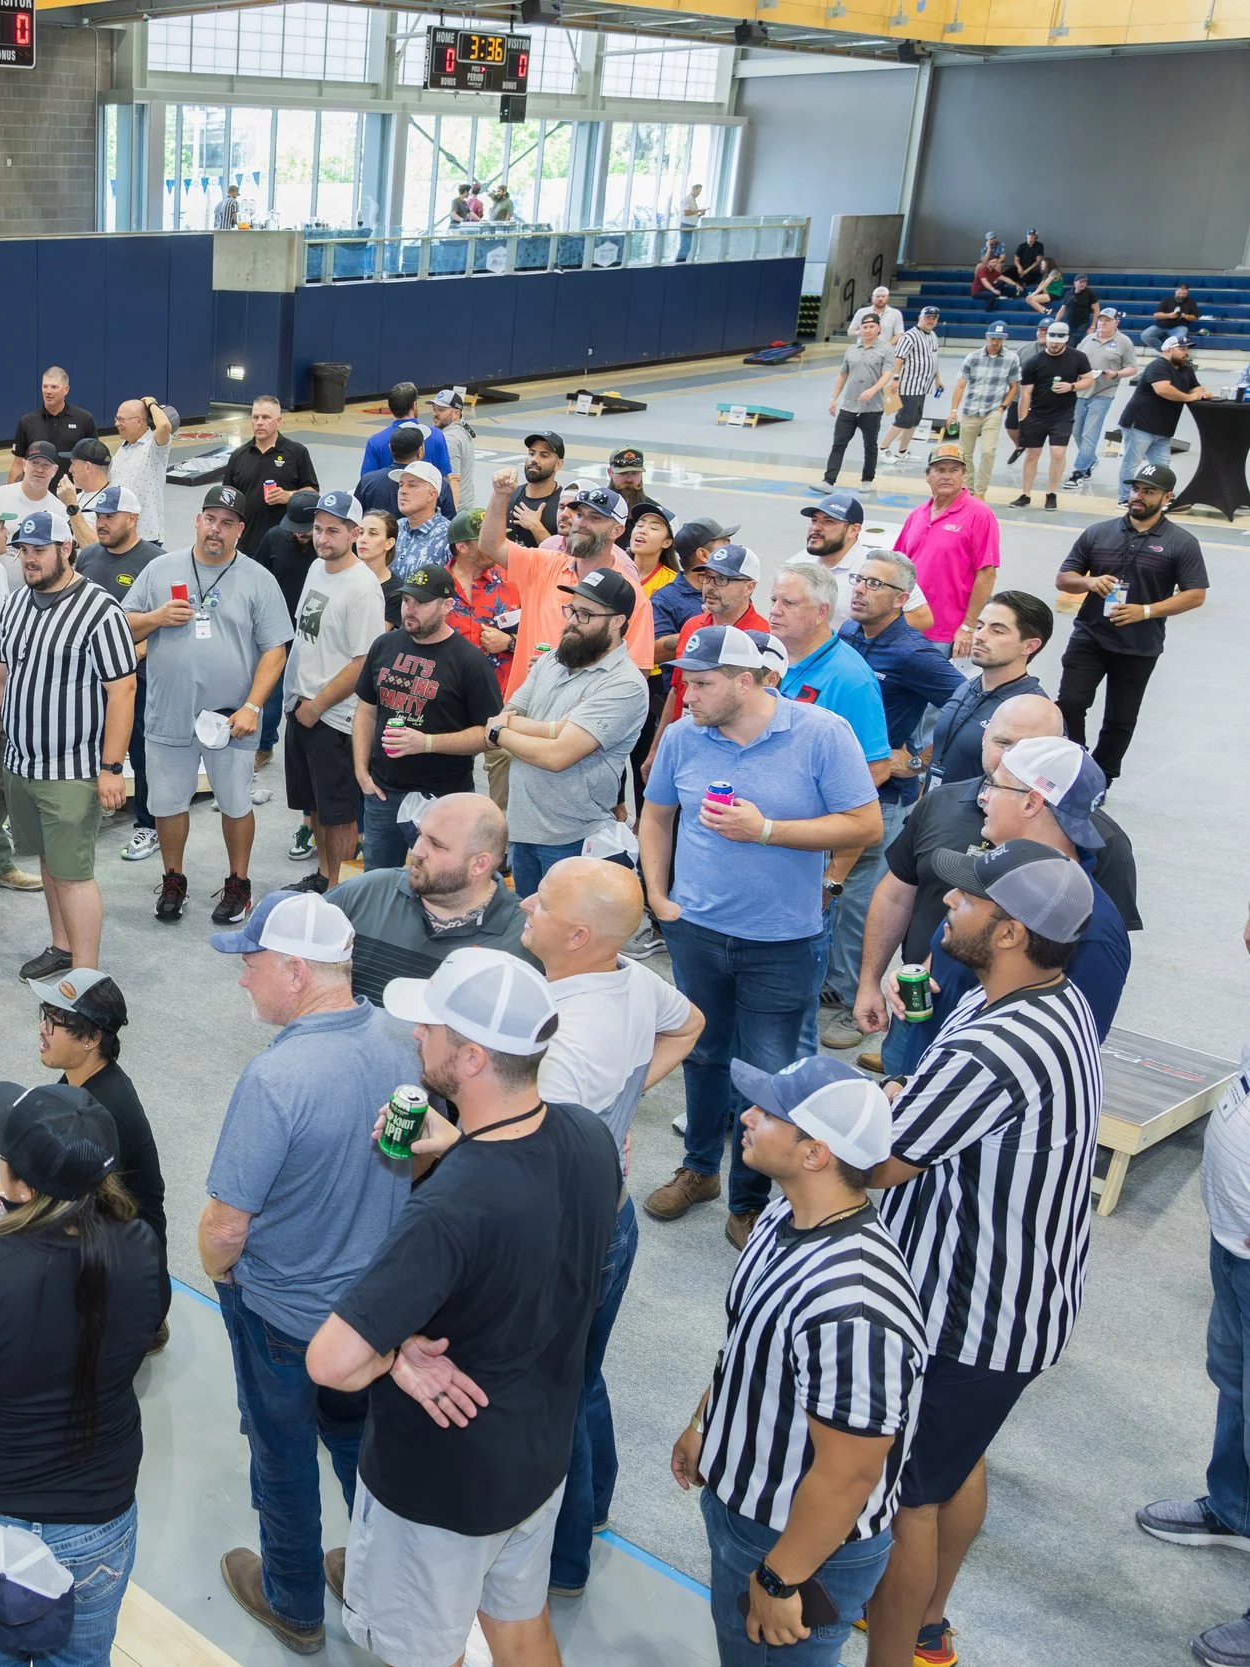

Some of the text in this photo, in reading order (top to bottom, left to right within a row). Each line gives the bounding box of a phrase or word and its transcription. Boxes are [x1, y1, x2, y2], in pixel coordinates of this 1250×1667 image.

[16, 13, 30, 45] 0
[435, 31, 455, 44] HOME
[470, 35, 503, 62] 3:36
[507, 37, 530, 51] VISITOR
[446, 47, 456, 72] 0
[518, 53, 528, 78] 0
[392, 652, 437, 679] LET'S
[379, 686, 428, 717] PARTY
[384, 1121, 403, 1142] IPA
